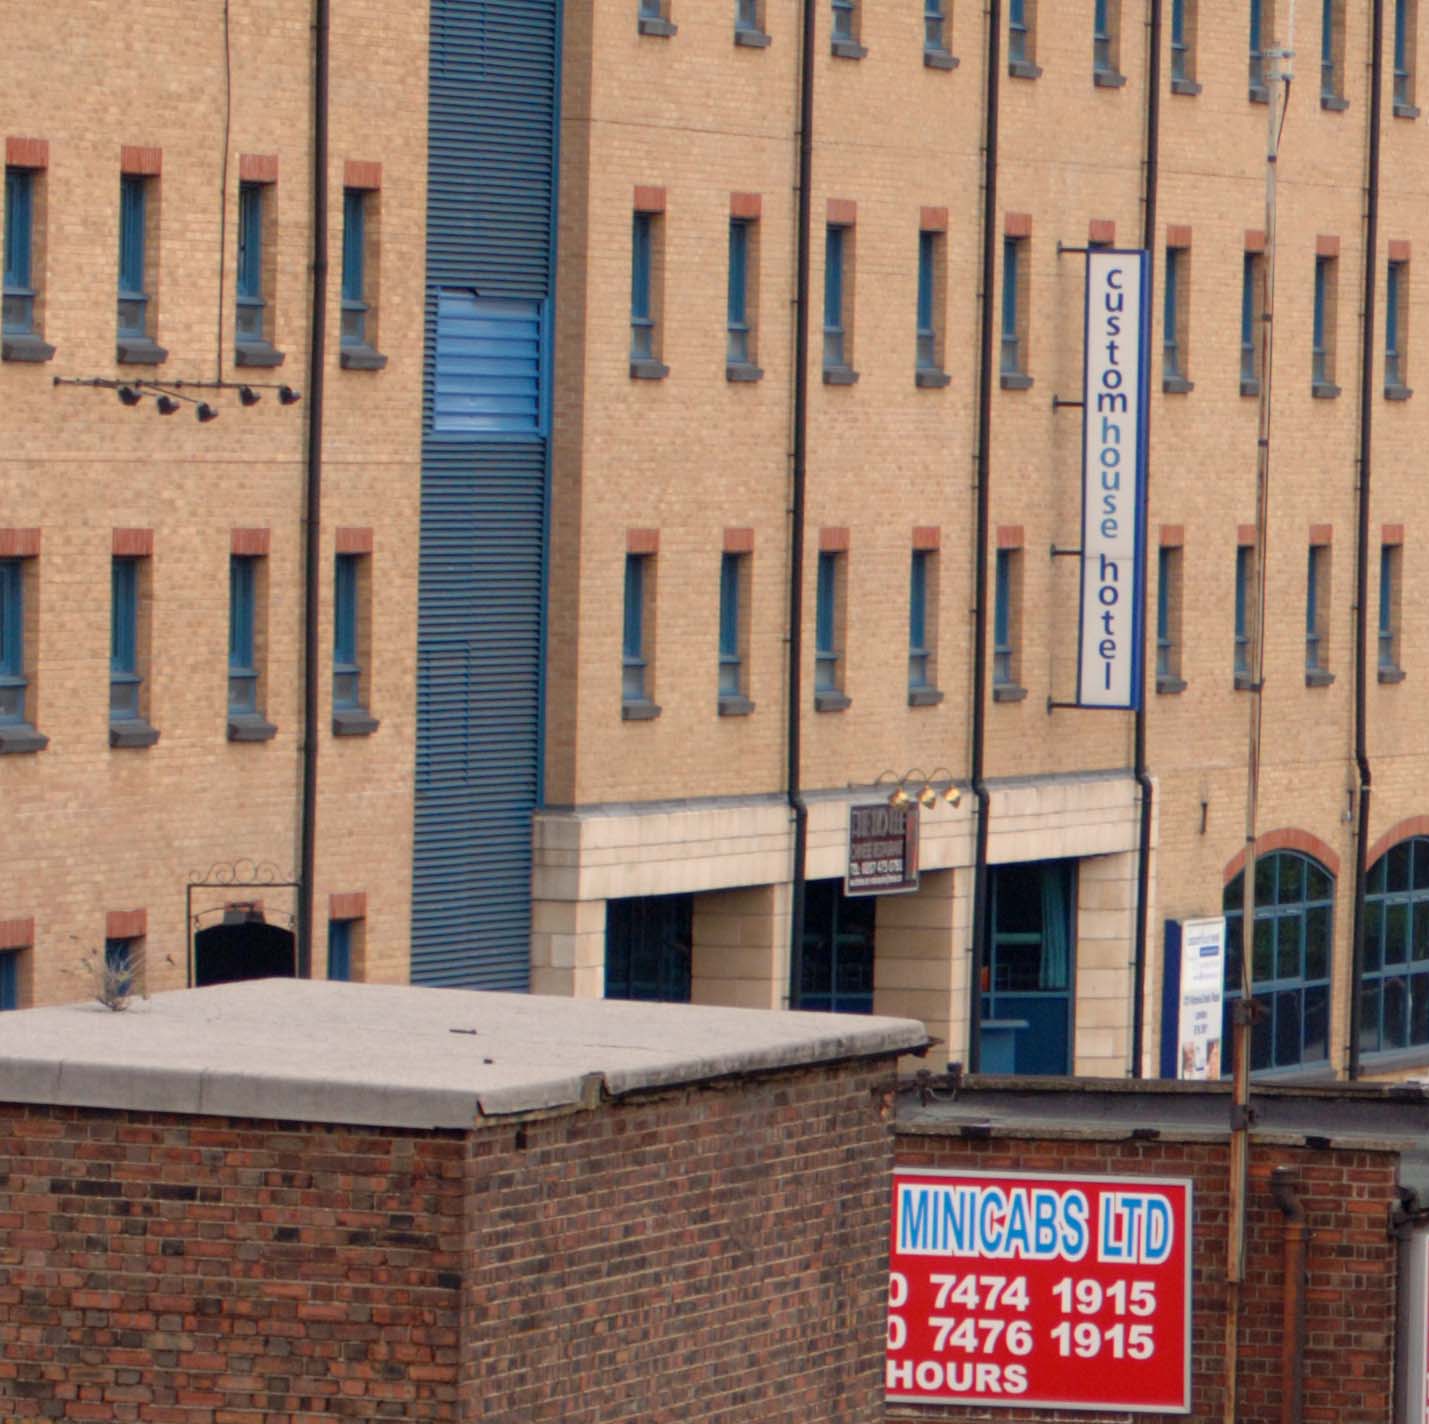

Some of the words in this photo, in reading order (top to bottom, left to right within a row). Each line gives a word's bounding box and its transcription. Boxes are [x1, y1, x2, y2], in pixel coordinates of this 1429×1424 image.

[1098, 553, 1119, 690] hotel
[898, 1184, 1089, 1261] MINICABS
[1098, 1192, 1174, 1264] LTD
[929, 1274, 1029, 1312] 7474
[1052, 1277, 1157, 1316] 1915
[928, 1317, 1034, 1356] 7476
[1050, 1321, 1154, 1360] 1915
[886, 1360, 1029, 1394] HOURS
